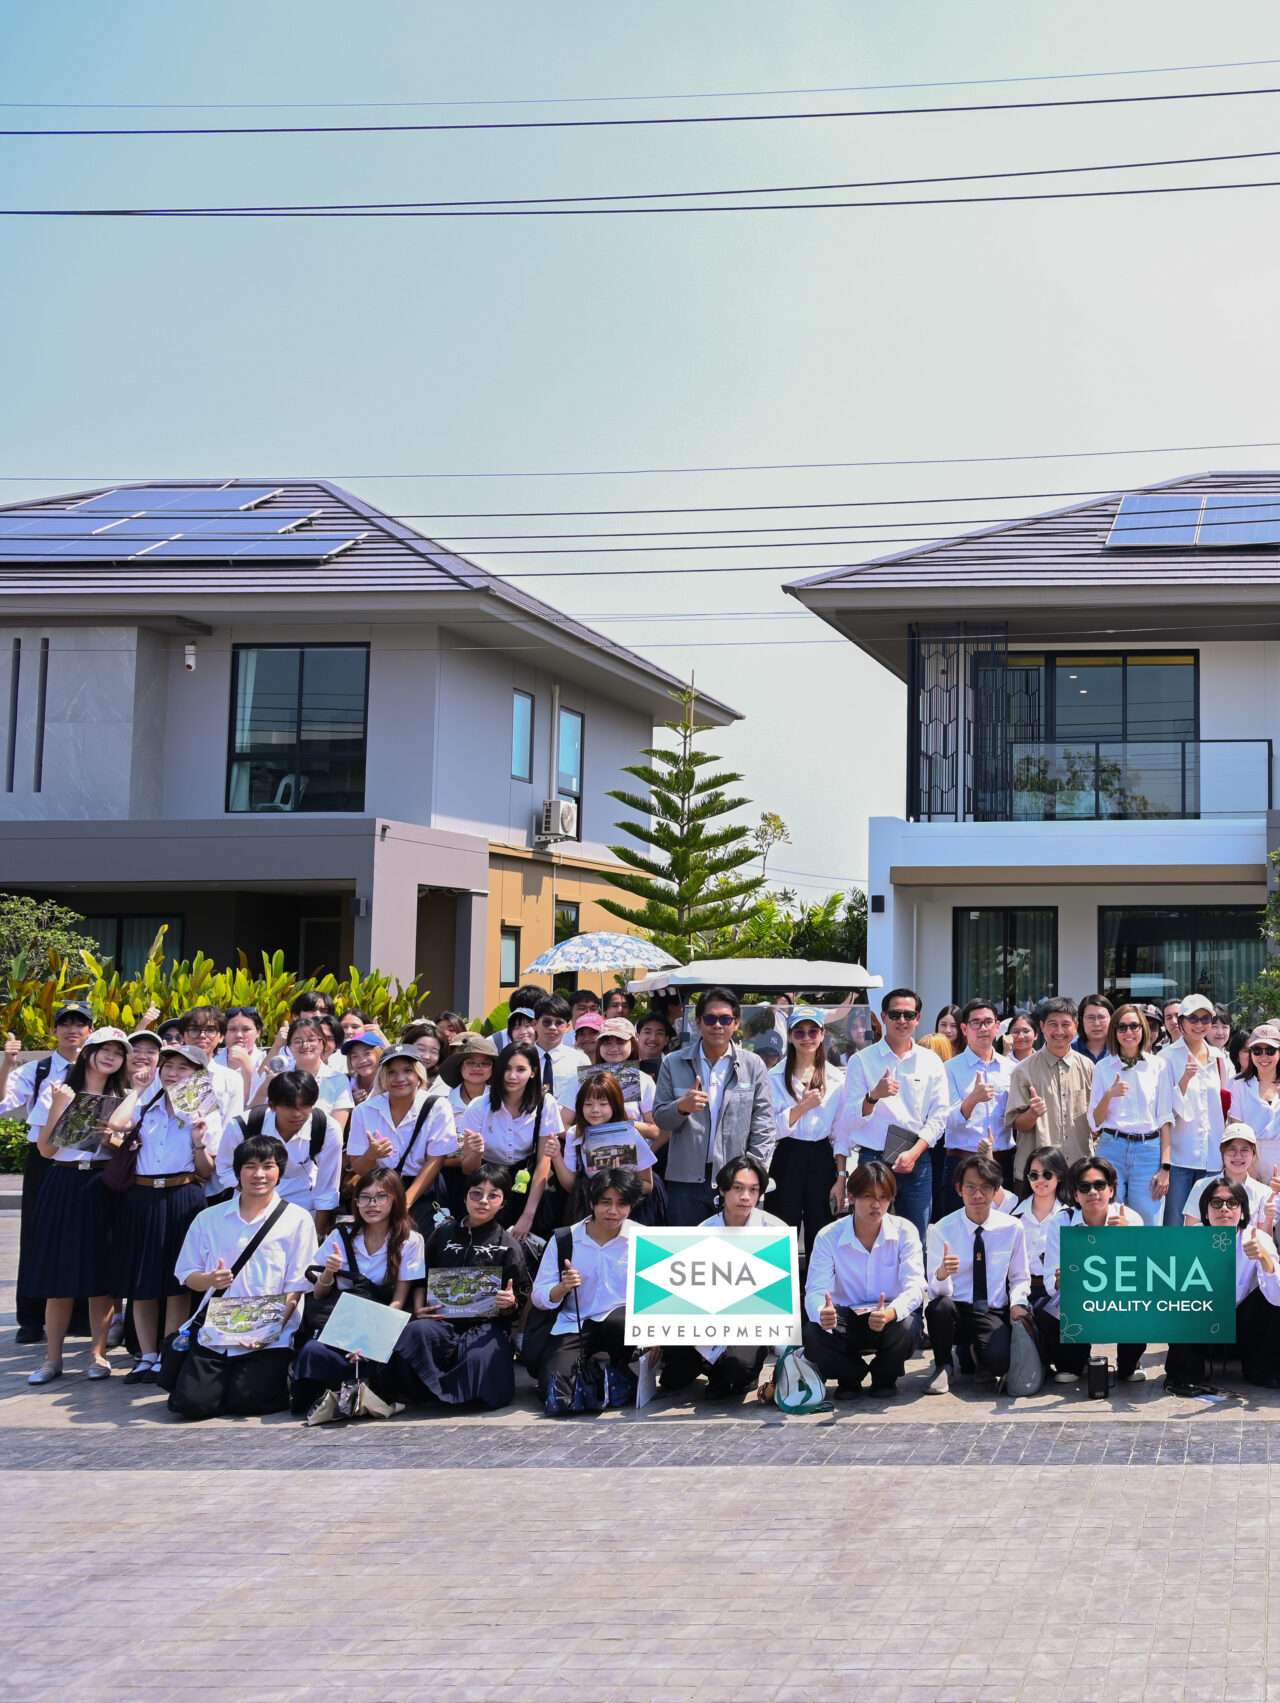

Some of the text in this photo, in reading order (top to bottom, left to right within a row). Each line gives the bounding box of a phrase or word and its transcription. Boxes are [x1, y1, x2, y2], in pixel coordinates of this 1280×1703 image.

[670, 1260, 757, 1286] SENA
[1083, 1255, 1213, 1292] SENA
[1082, 1300, 1213, 1313] QUALITY CHECK
[631, 1325, 795, 1338] DEVELOPMENT
